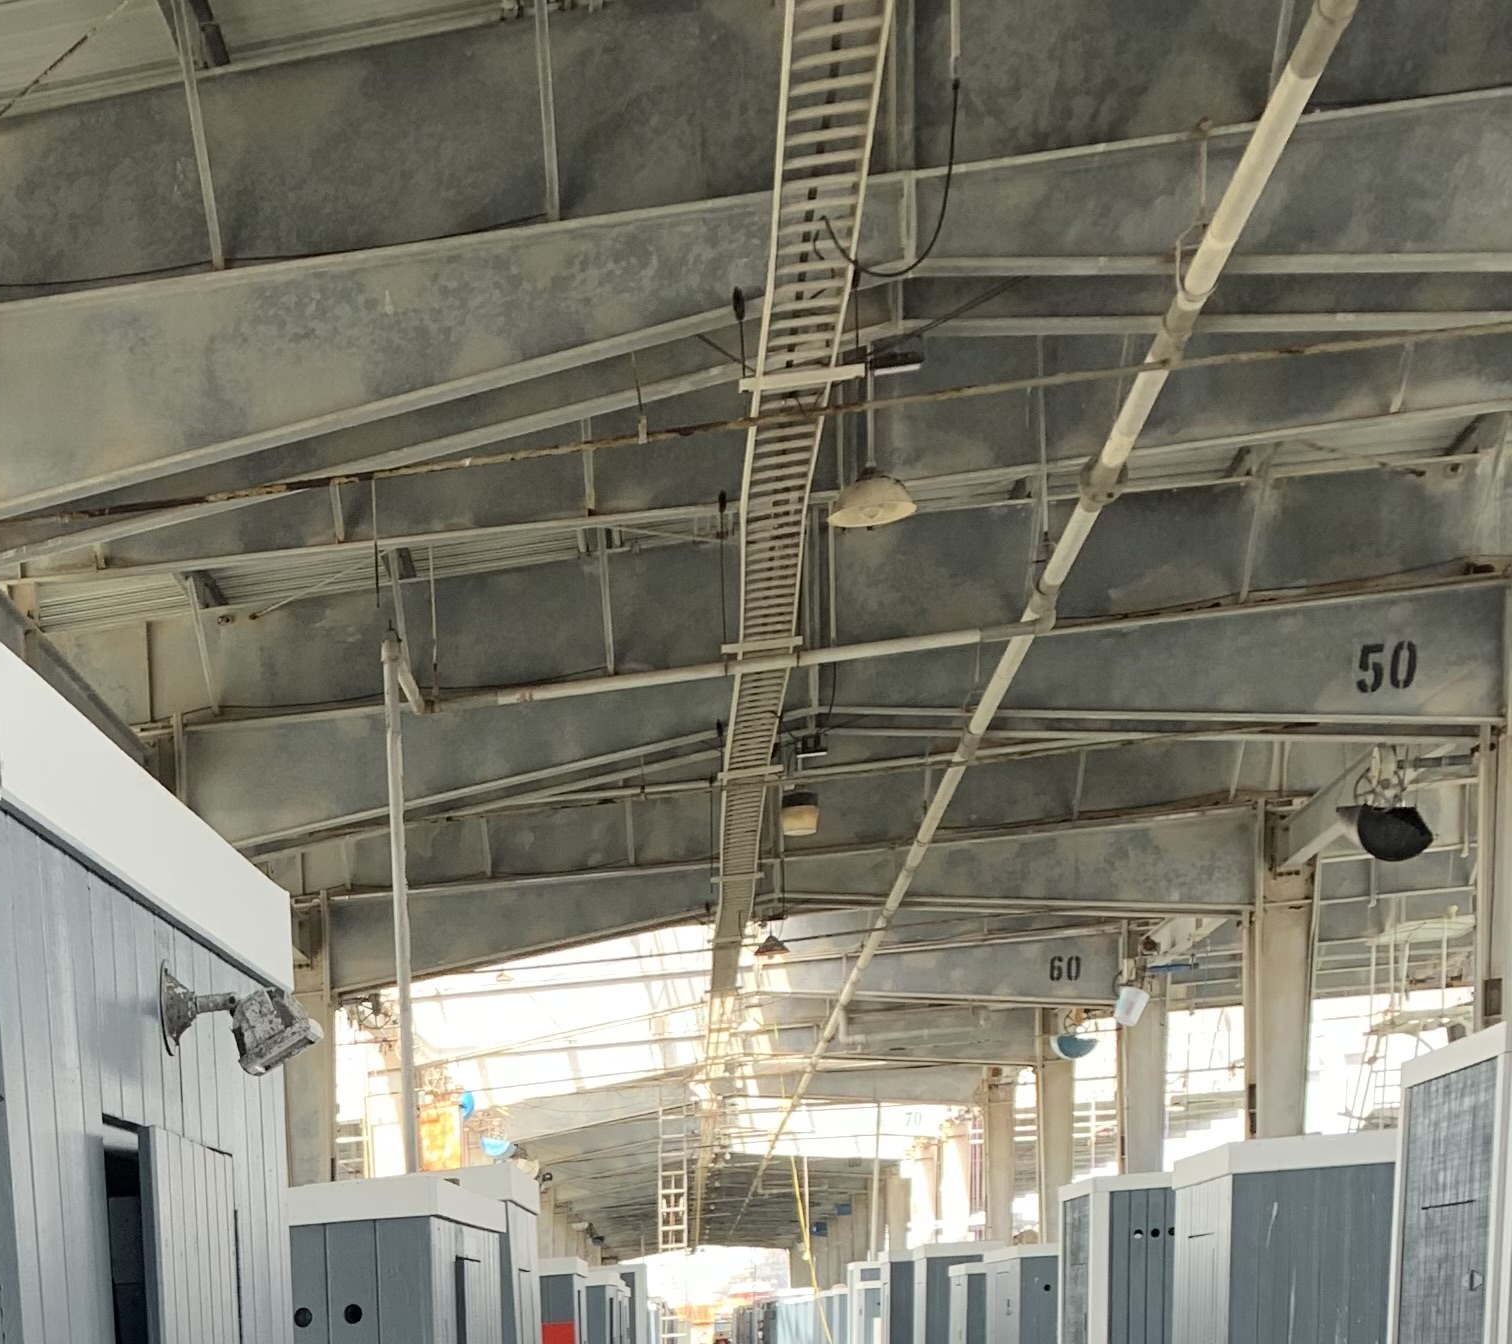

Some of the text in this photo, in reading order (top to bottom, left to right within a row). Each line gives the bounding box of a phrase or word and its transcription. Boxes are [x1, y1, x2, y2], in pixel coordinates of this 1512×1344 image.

[1356, 640, 1418, 694] 50
[1049, 955, 1082, 982] 60
[905, 1111, 923, 1127] 70
